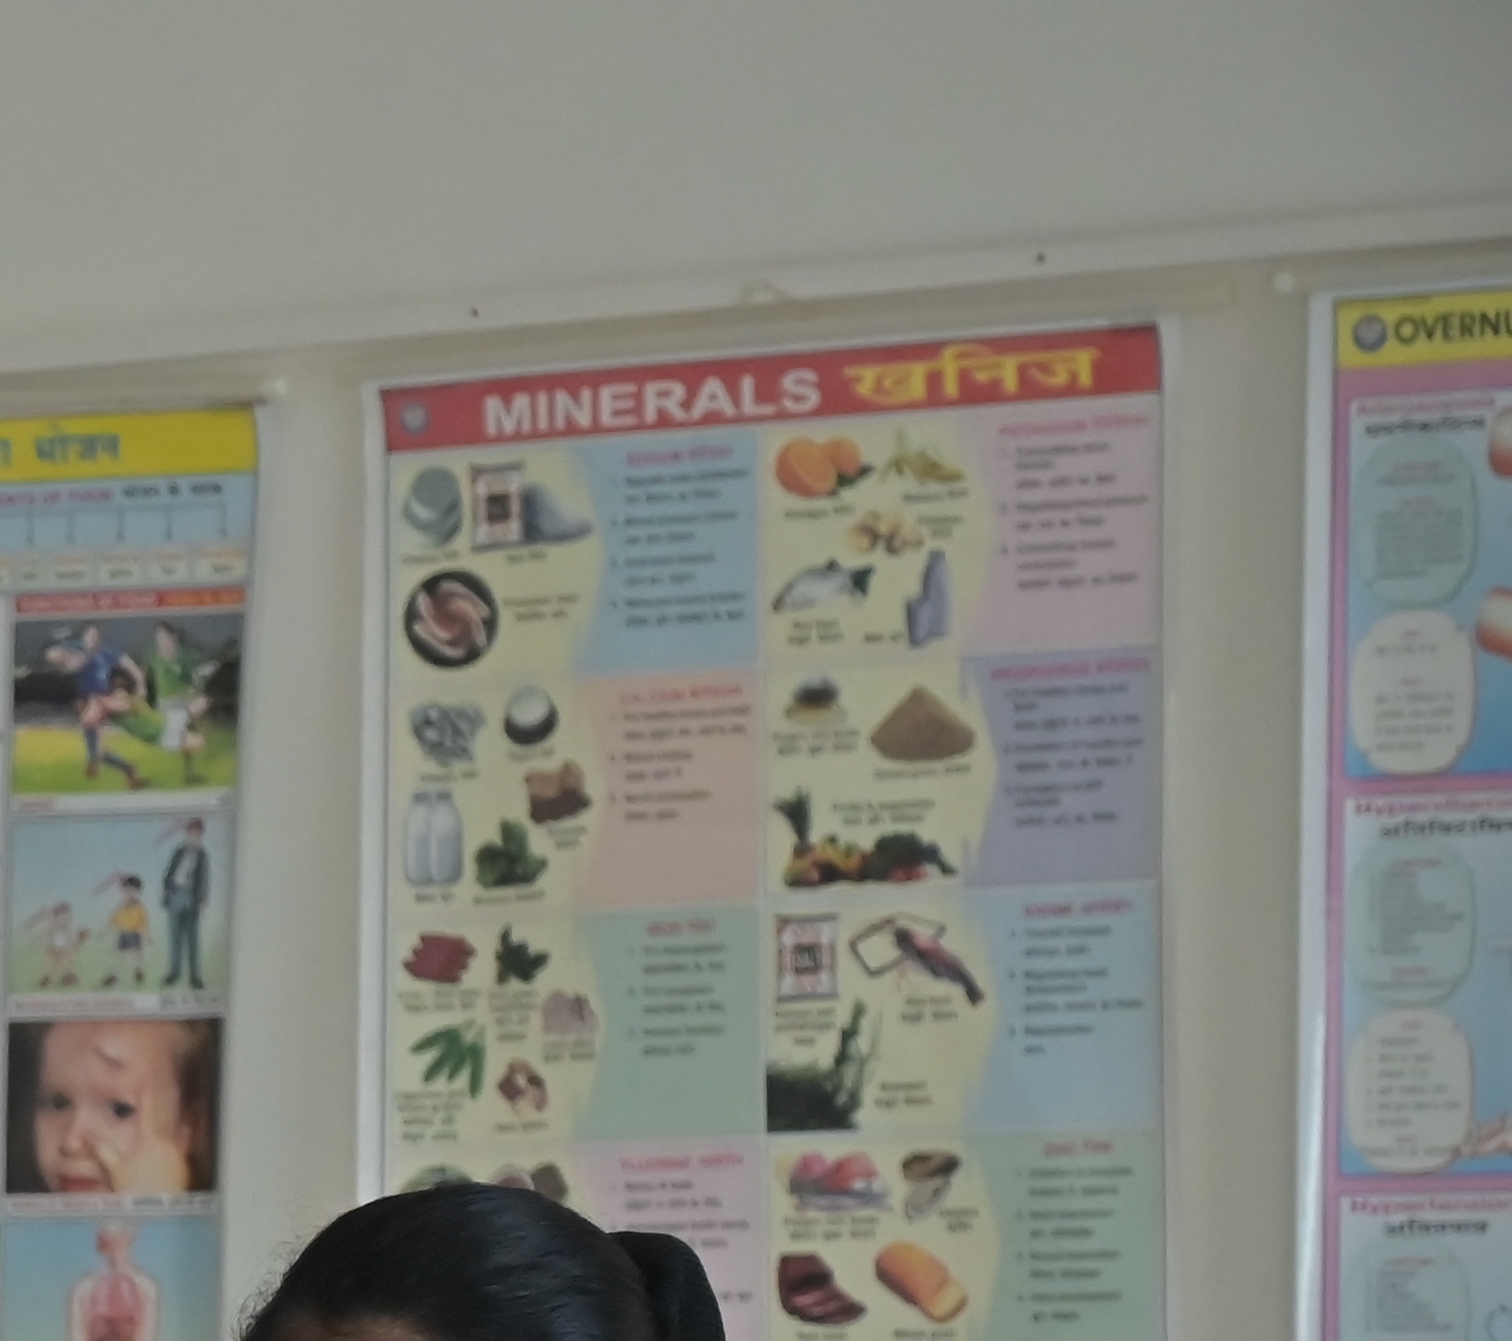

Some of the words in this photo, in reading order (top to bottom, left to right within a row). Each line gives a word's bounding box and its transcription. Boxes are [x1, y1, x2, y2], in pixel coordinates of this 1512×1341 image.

[484, 368, 822, 438] MINERALS
[844, 343, 1100, 404] खनिज
[34, 422, 120, 463] भोजन
